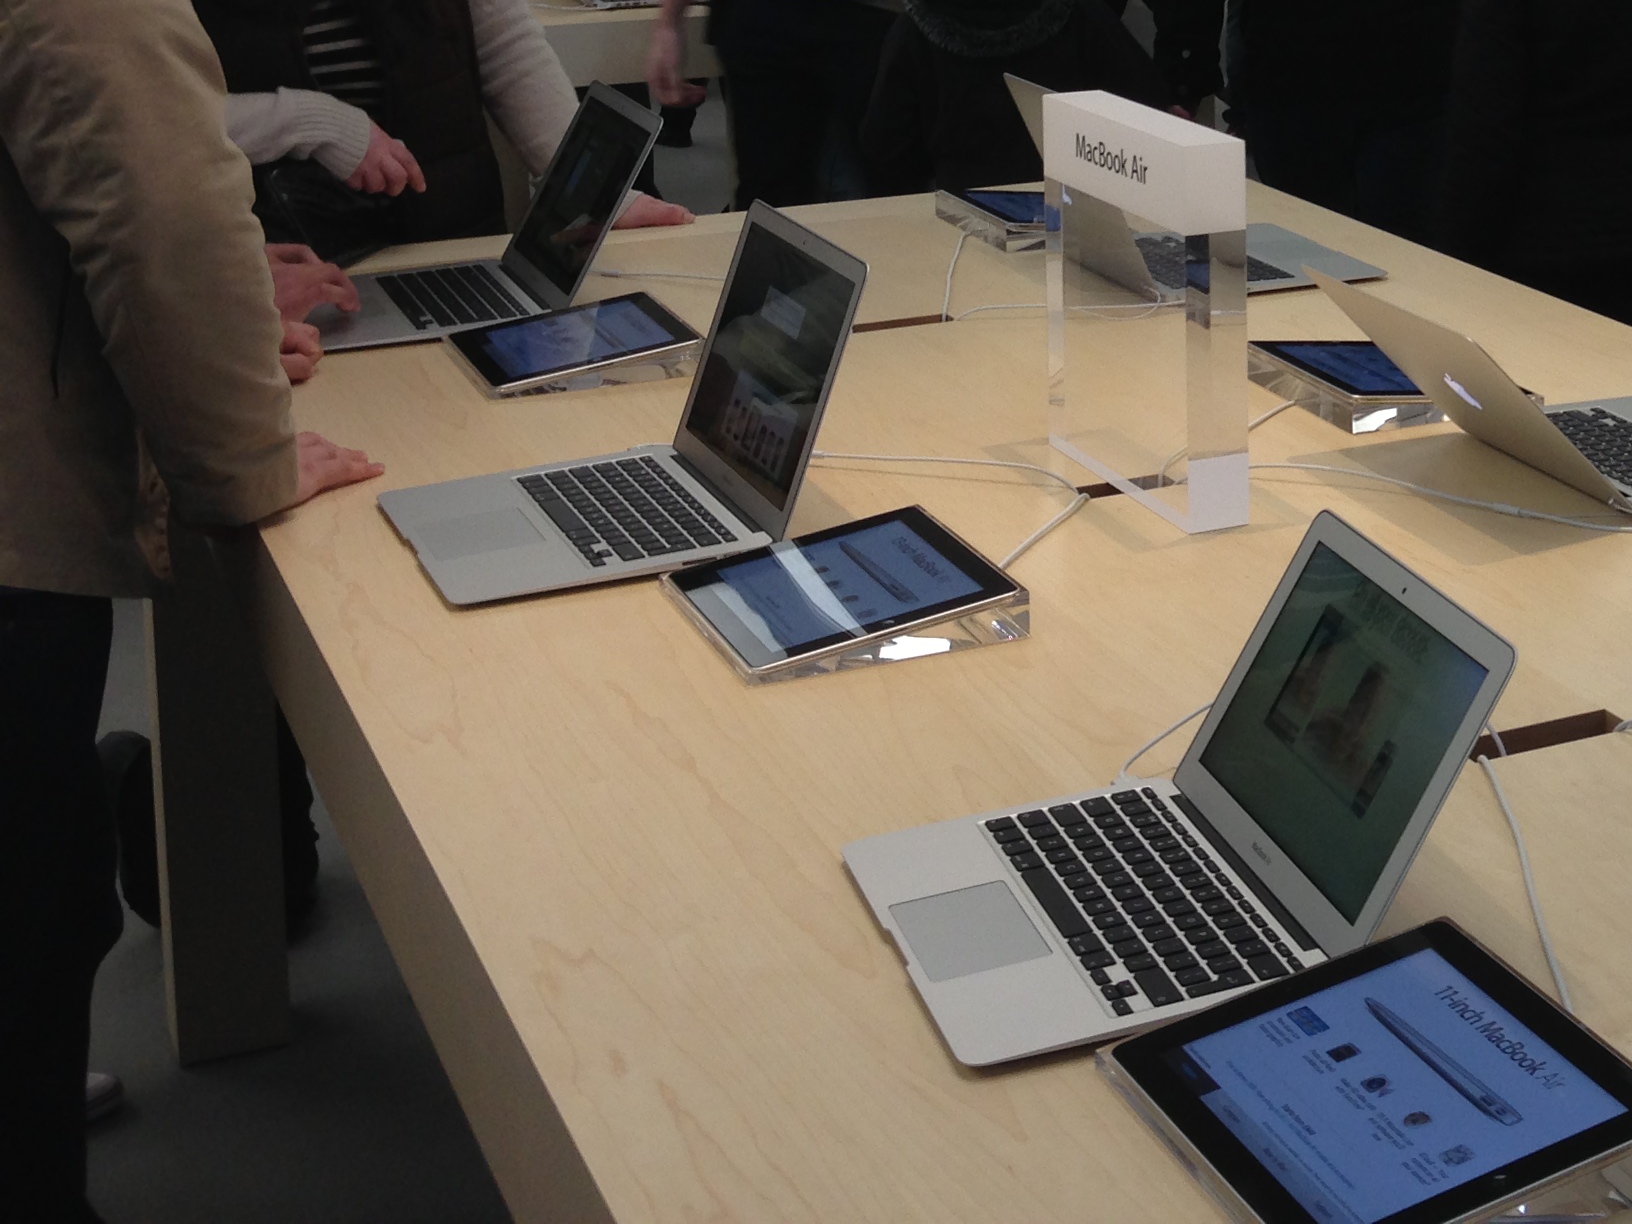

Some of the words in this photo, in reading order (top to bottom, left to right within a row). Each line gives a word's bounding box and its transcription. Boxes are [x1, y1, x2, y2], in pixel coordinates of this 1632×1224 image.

[1075, 132, 1128, 178] MacBook
[1130, 154, 1148, 185] Air
[1433, 984, 1486, 1026] 11-inch
[1474, 1020, 1547, 1077] MacBook
[1535, 1072, 1566, 1090] Air
